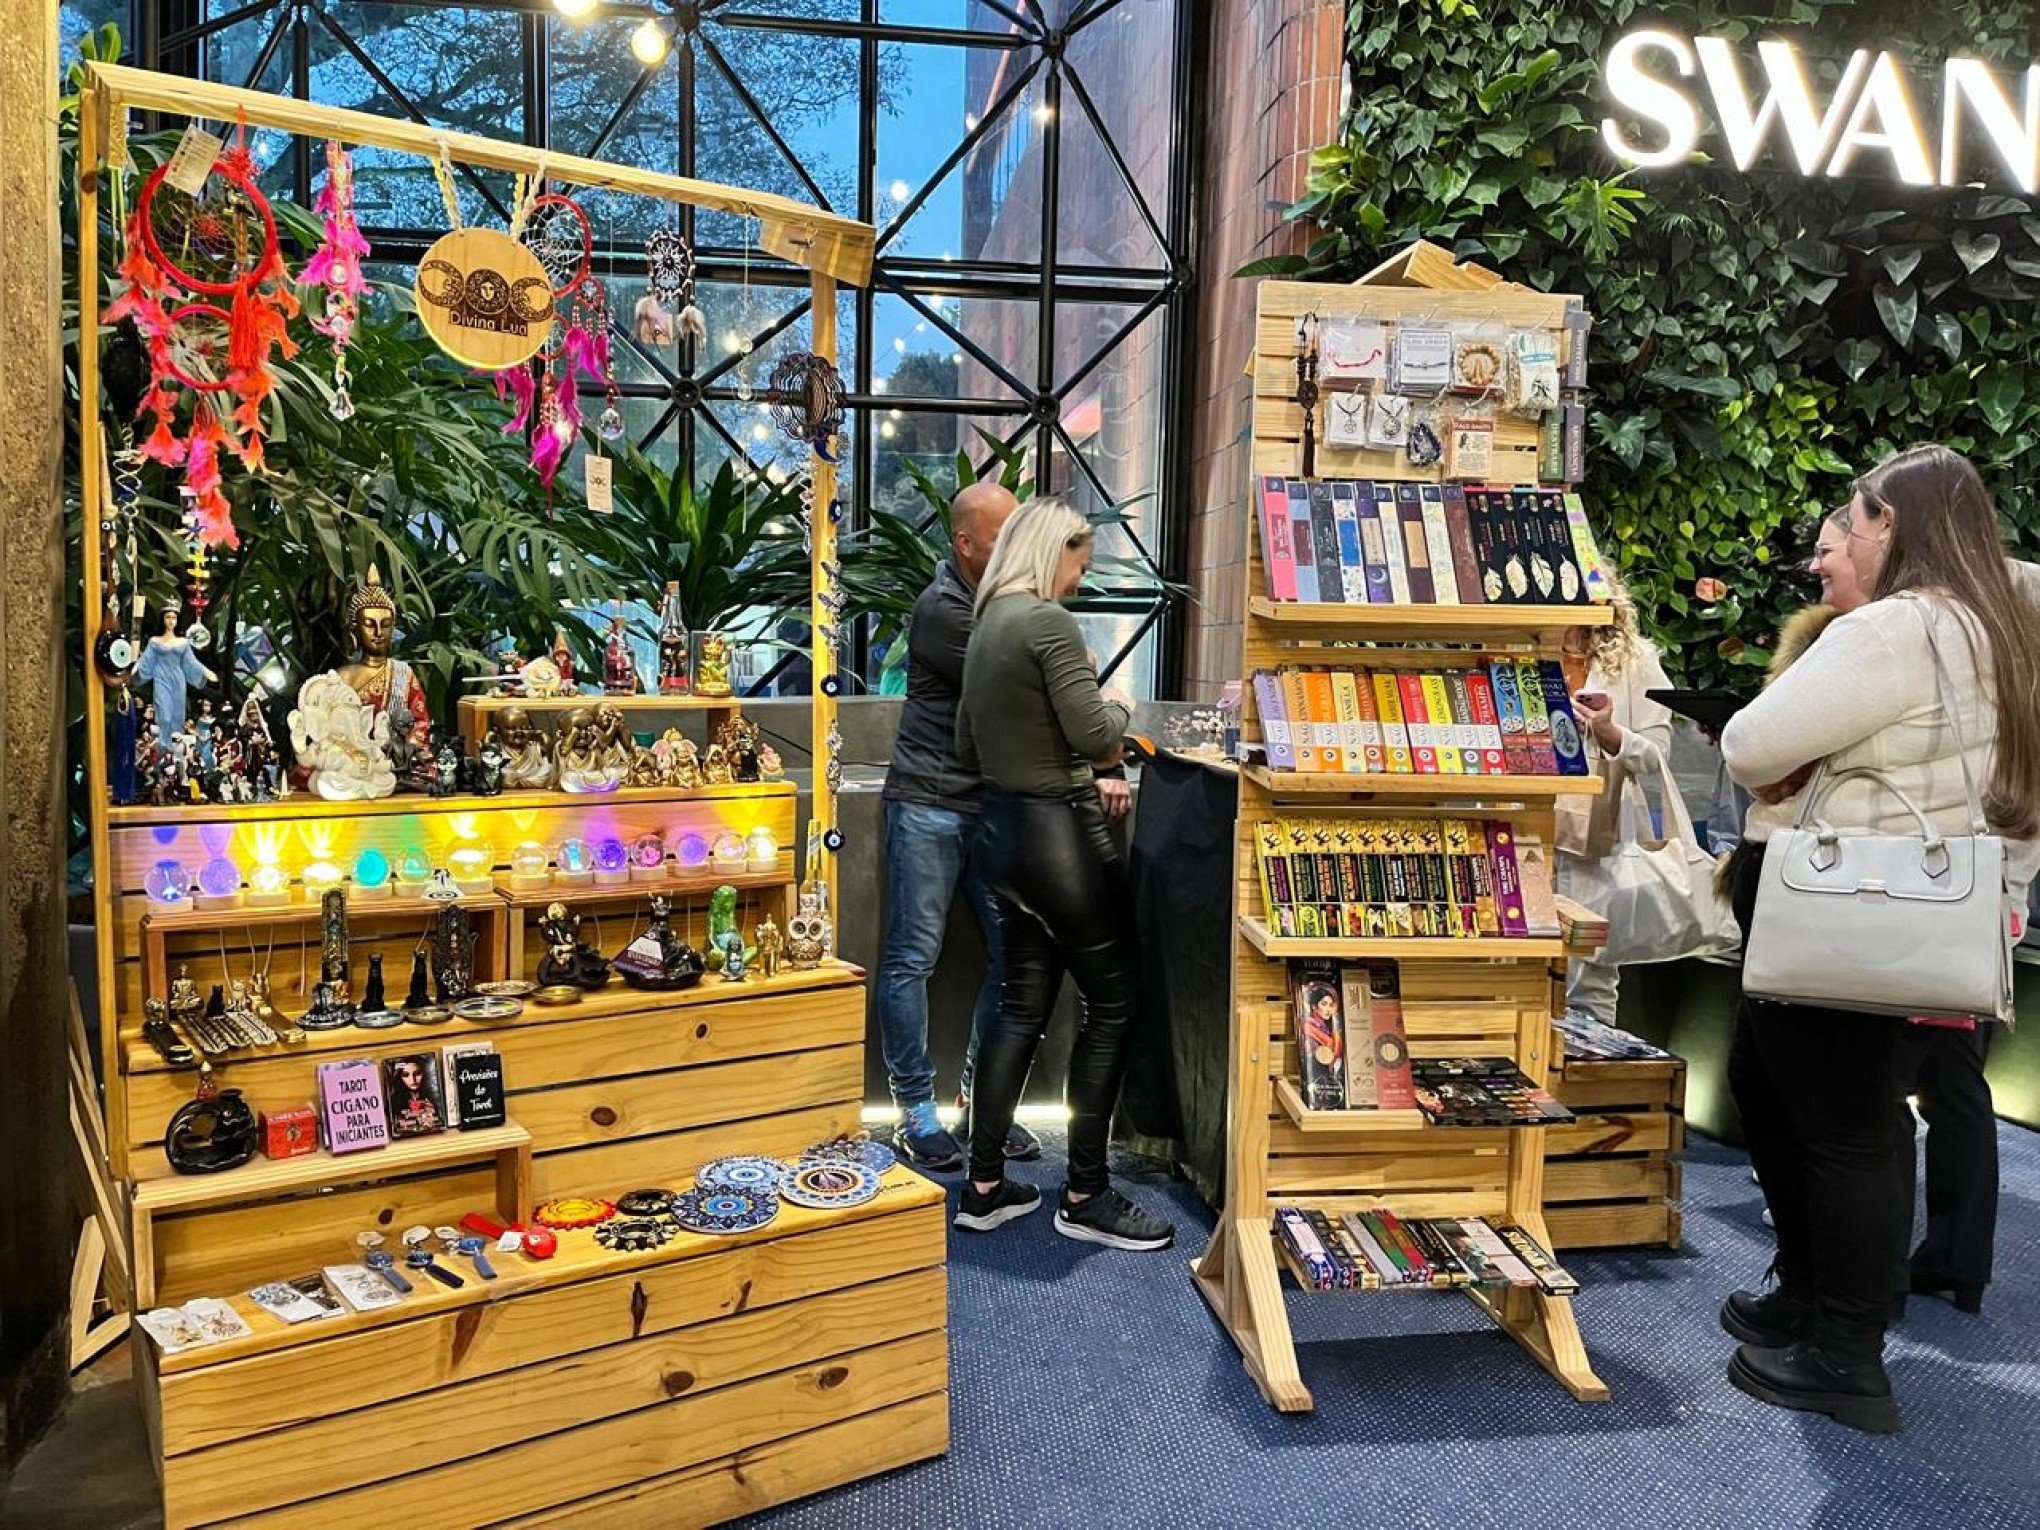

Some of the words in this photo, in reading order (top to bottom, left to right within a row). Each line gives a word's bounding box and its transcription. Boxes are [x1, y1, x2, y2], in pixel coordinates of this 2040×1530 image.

[1602, 31, 2040, 194] SWAN
[451, 310, 495, 331] Divina
[501, 317, 528, 336] Lua
[459, 1069, 498, 1084] Previsões
[339, 1079, 367, 1094] TAROT
[331, 1096, 379, 1115] CIGANO
[470, 1098, 492, 1112] Tarot
[346, 1112, 370, 1128] PARA
[336, 1124, 385, 1144] INICIANTES
